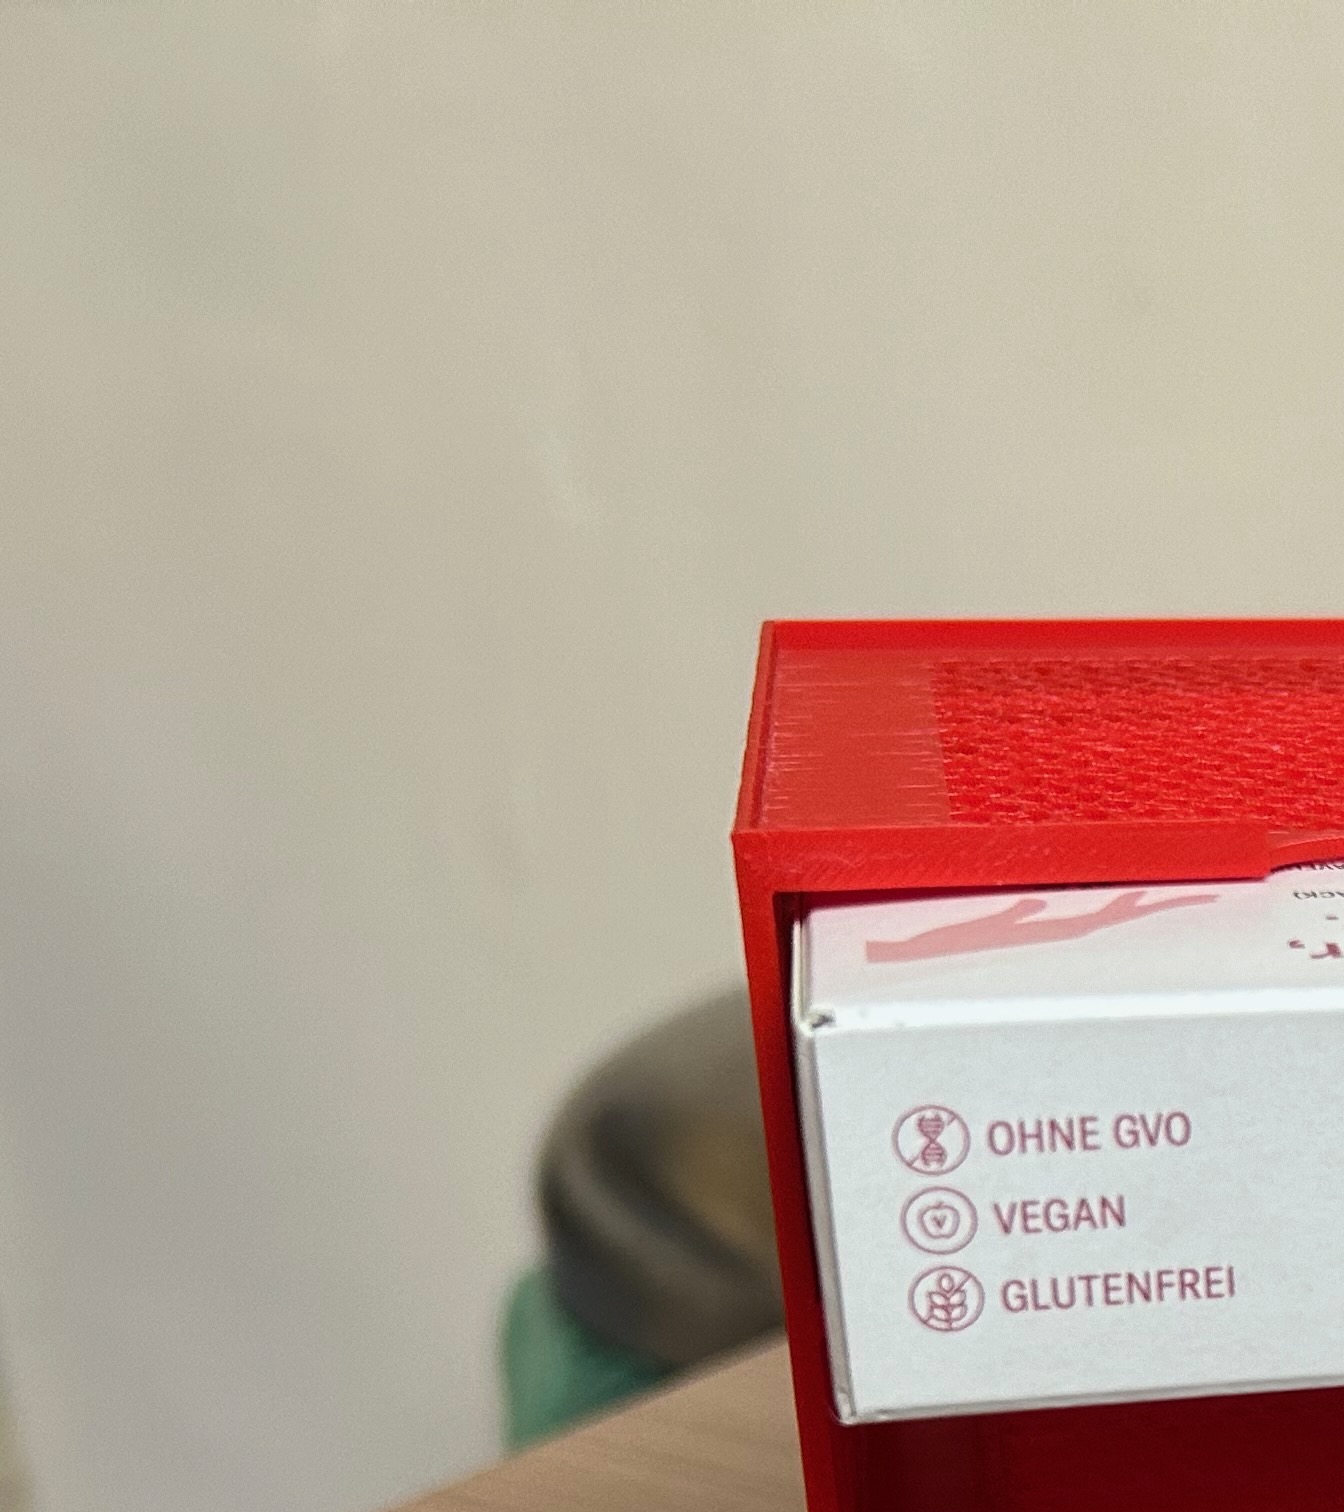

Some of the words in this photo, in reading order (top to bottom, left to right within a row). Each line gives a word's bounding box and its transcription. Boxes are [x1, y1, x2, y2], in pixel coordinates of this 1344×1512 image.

[986, 1113, 1101, 1157] OHNE
[1112, 1110, 1193, 1151] GVO
[993, 1194, 1127, 1236] VEGAN
[1001, 1264, 1236, 1314] GLUTENFREI
